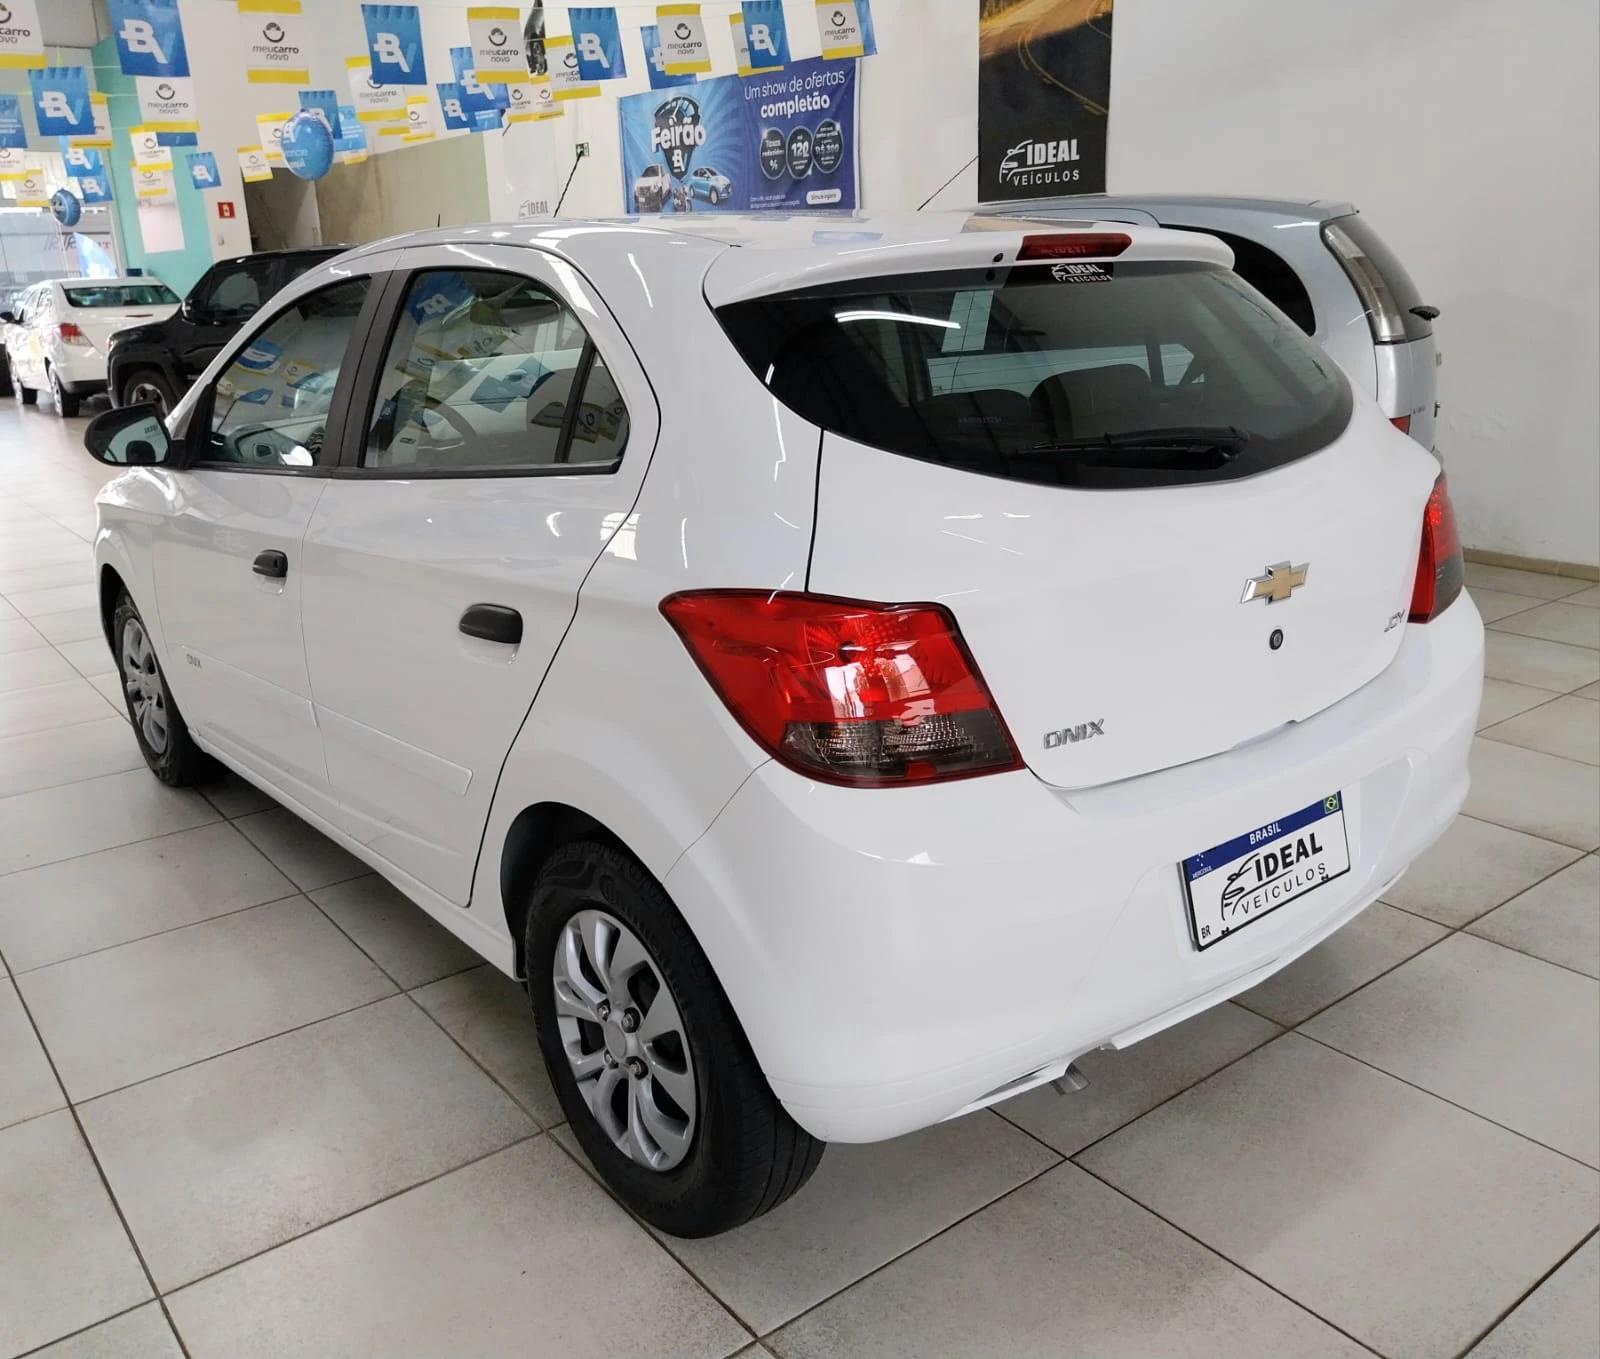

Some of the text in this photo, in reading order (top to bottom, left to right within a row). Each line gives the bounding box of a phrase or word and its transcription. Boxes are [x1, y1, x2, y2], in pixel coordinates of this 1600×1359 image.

[825, 27, 856, 36] meucarro
[252, 44, 300, 55] meucarro
[667, 41, 703, 49] meucarro
[266, 53, 289, 61] novo
[744, 70, 846, 100] Um show de ofertas
[760, 91, 831, 119] completão
[651, 116, 706, 153] Feirão
[1026, 139, 1081, 166] IDEAL
[1013, 169, 1081, 187] VEÍCULOS
[527, 200, 549, 216] IDEAL
[1065, 263, 1105, 274] IDEAL
[1043, 718, 1105, 750] ONIX
[1249, 822, 1282, 845] BRASIL
[1254, 832, 1323, 883] IDEAL
[1241, 862, 1327, 915] VEÍCULOS
[1201, 924, 1212, 939] BR
